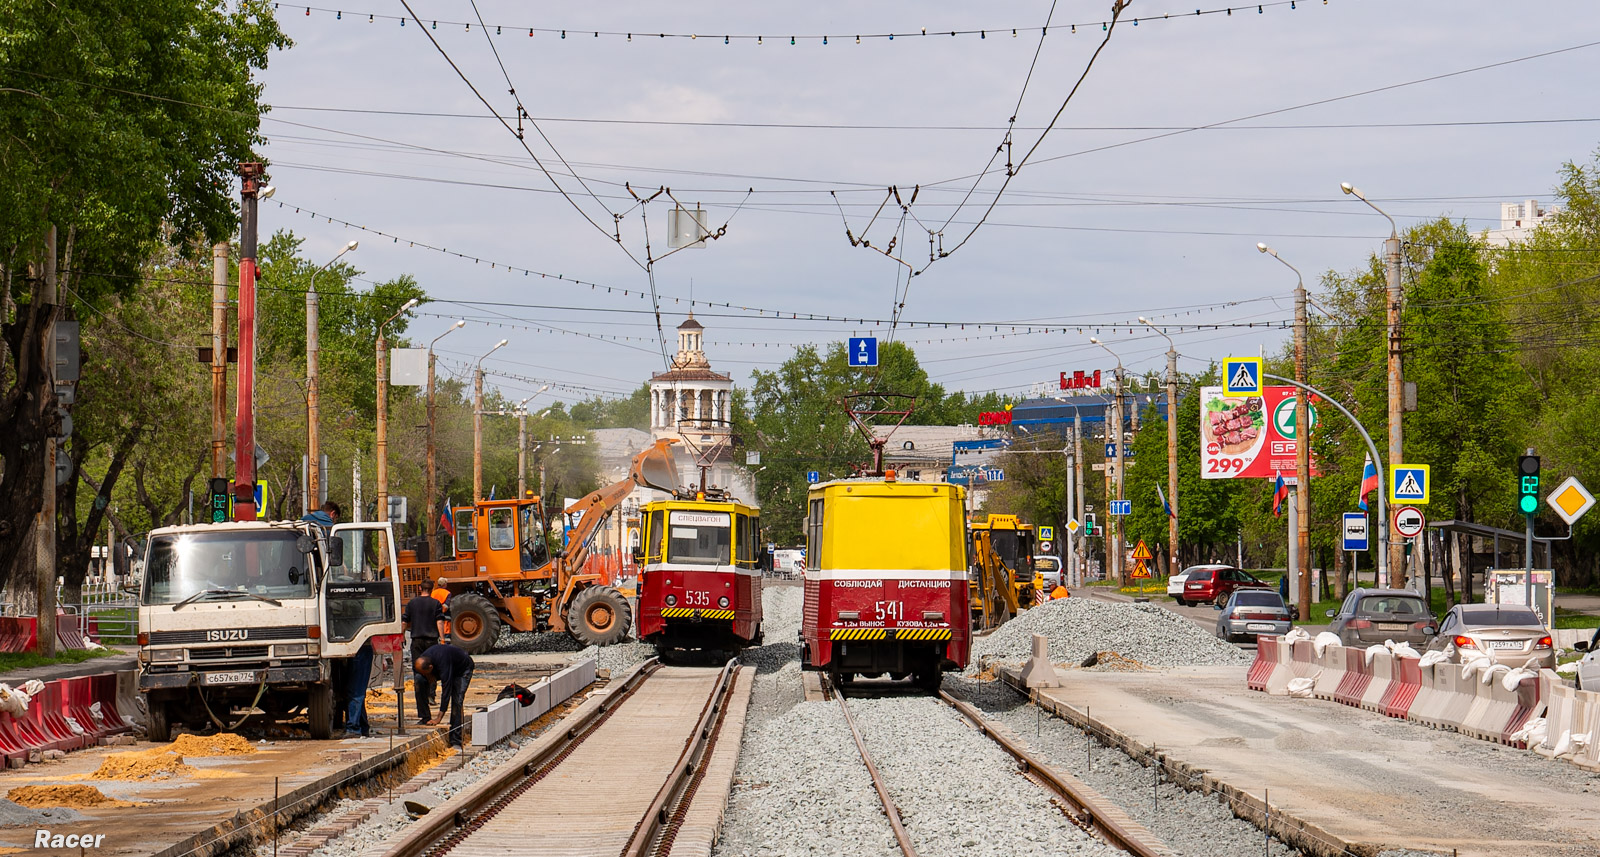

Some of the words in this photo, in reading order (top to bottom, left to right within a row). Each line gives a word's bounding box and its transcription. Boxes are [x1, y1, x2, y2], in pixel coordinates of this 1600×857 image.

[1207, 457, 1244, 473] 299
[1522, 475, 1539, 494] 62
[214, 494, 226, 508] 62
[678, 514, 721, 523] СПЕЦВАГОН
[834, 579, 883, 588] СОБЛЮДАЙ
[898, 580, 951, 589] ДИСТАНЦИЮ
[685, 590, 710, 606] 535
[875, 601, 904, 620] 541
[206, 629, 249, 641] ISUZU
